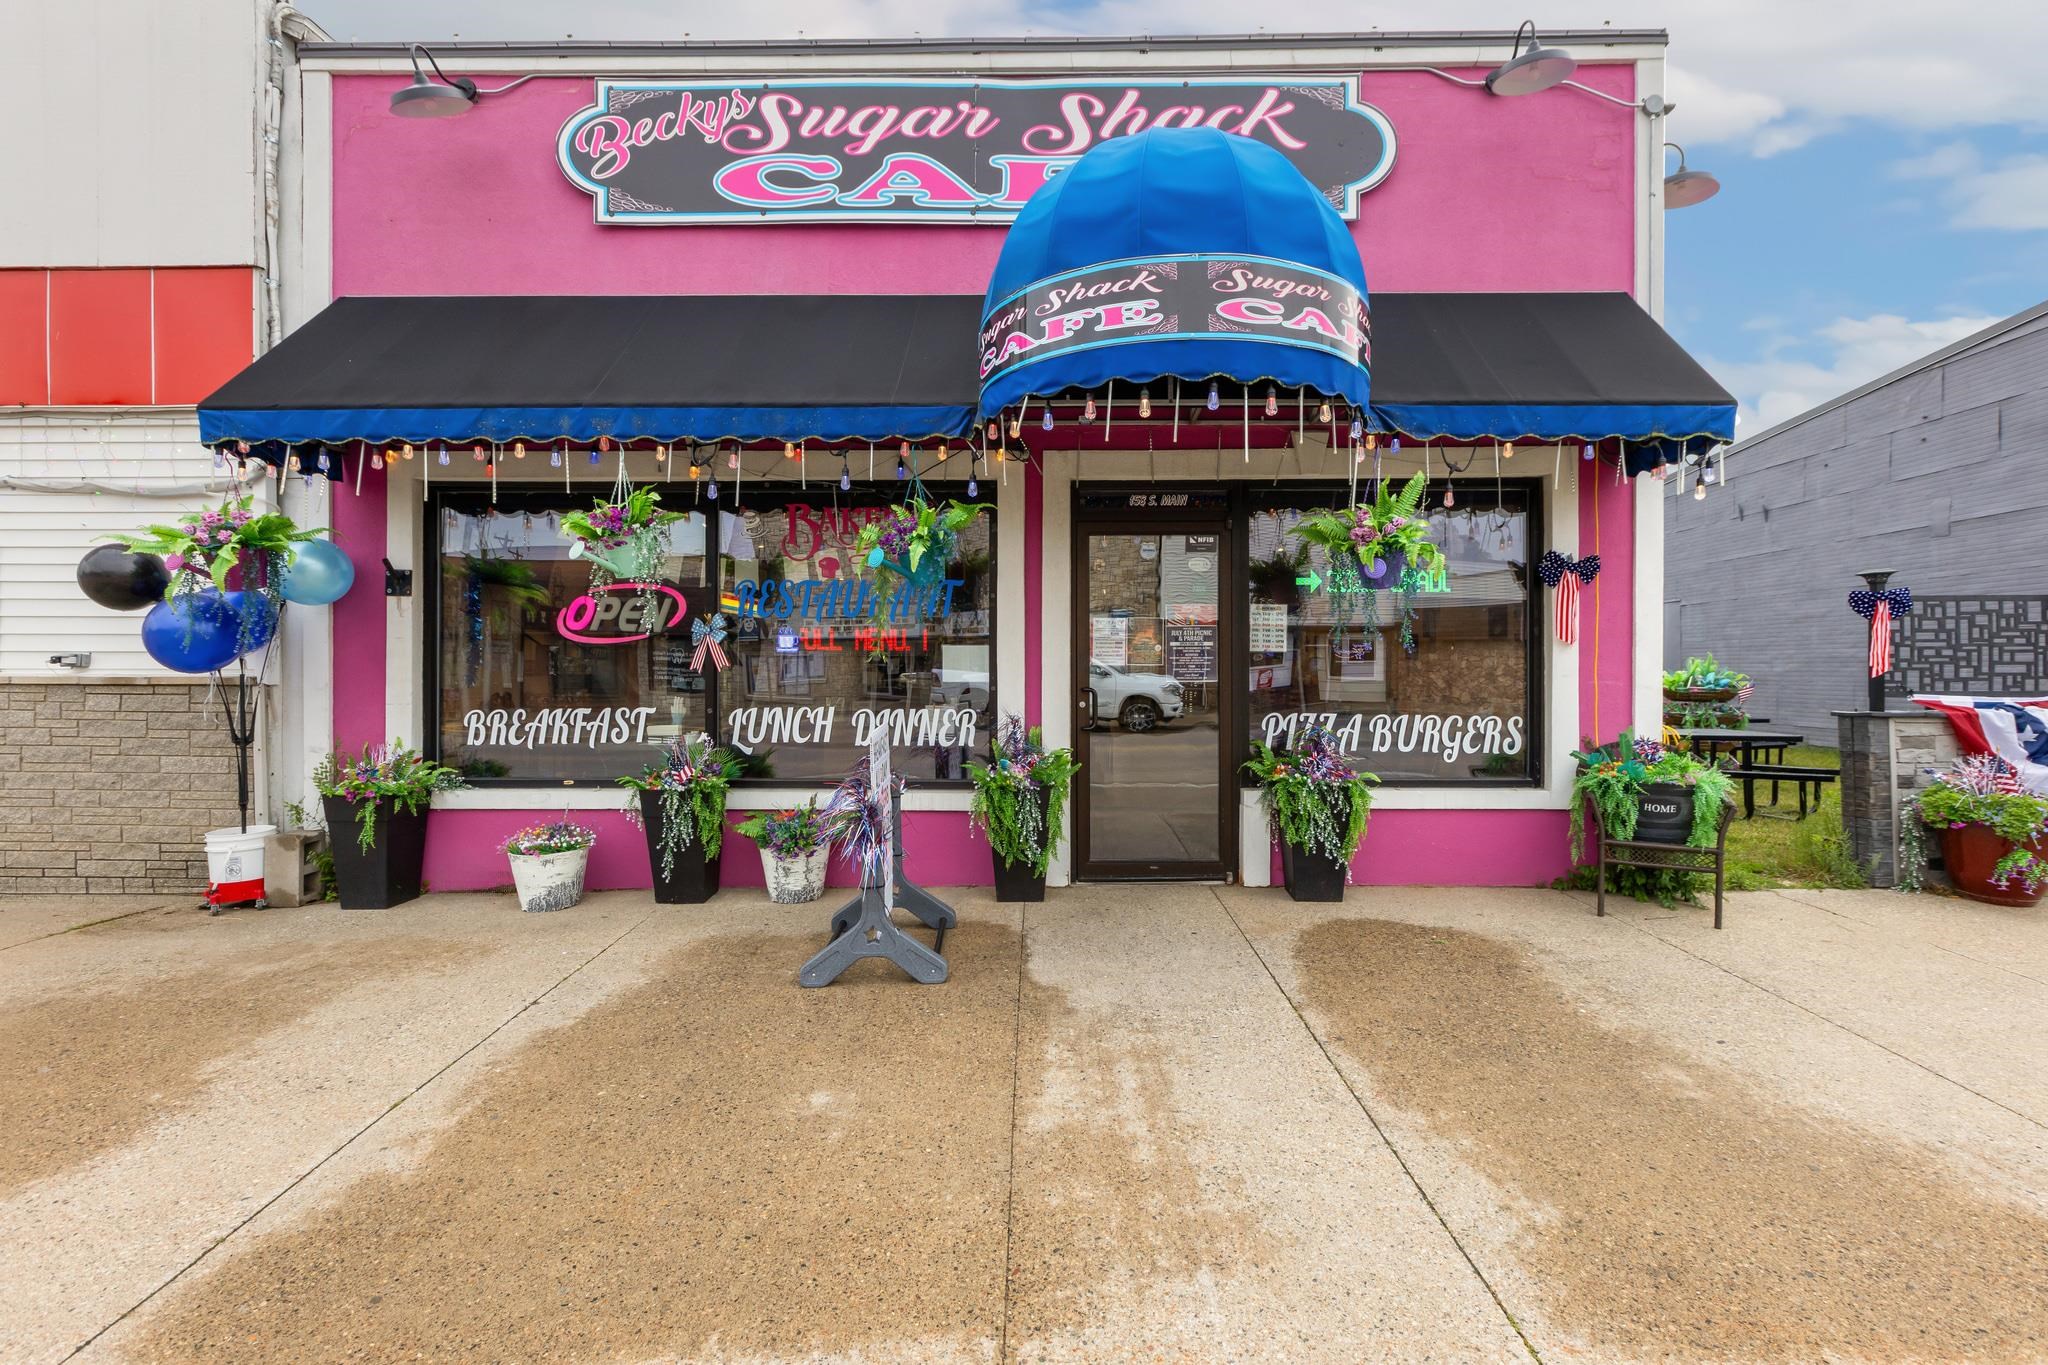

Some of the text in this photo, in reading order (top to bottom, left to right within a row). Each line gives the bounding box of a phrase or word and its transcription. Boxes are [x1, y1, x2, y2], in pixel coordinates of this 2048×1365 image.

[721, 93, 1000, 154] Sugar
[713, 153, 1086, 208] CAF
[1035, 271, 1163, 316] Shack
[1212, 269, 1332, 301] Sugar
[980, 299, 1164, 379] CAFE
[1160, 494, 1188, 506] MAIN
[565, 595, 673, 632] OPEN
[463, 707, 657, 749] BREAKFAST
[728, 706, 836, 755] LUNCH
[1369, 714, 1524, 763] BURGERS
[1644, 803, 1678, 813] HOME
